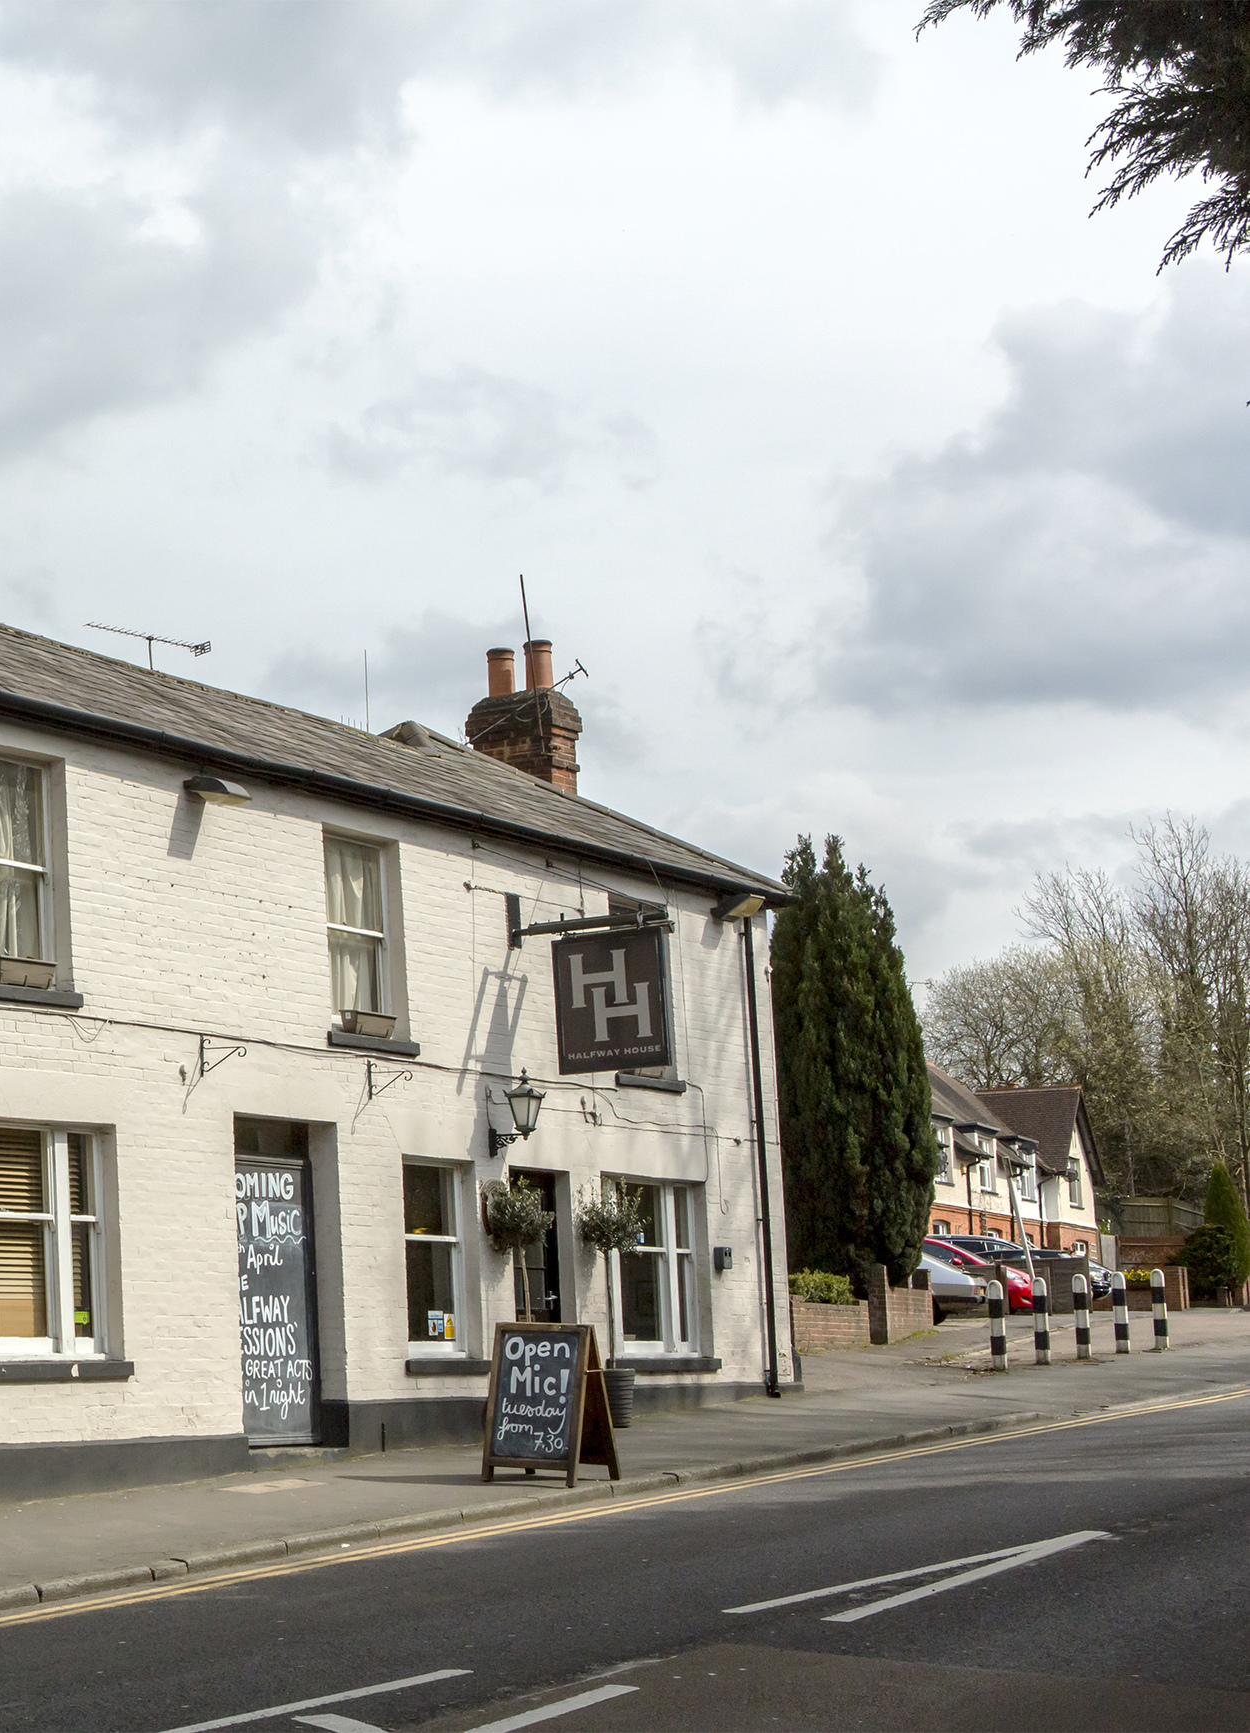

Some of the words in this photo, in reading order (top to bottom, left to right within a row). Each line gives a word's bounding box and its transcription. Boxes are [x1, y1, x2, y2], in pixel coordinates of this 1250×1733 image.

[568, 1048, 620, 1060] HALFWAY
[623, 1044, 662, 1056] HOUSE
[251, 1200, 303, 1238] Music
[247, 1243, 283, 1274] April
[237, 1274, 249, 1291] E
[239, 1321, 298, 1357] SSIONS'
[505, 1336, 570, 1367] Open
[245, 1358, 284, 1379] GREAT
[286, 1359, 313, 1381] ACTS
[509, 1364, 570, 1404] Mic!
[244, 1379, 259, 1406] in
[259, 1382, 270, 1411] 1
[269, 1378, 306, 1420] night
[497, 1417, 534, 1440] from
